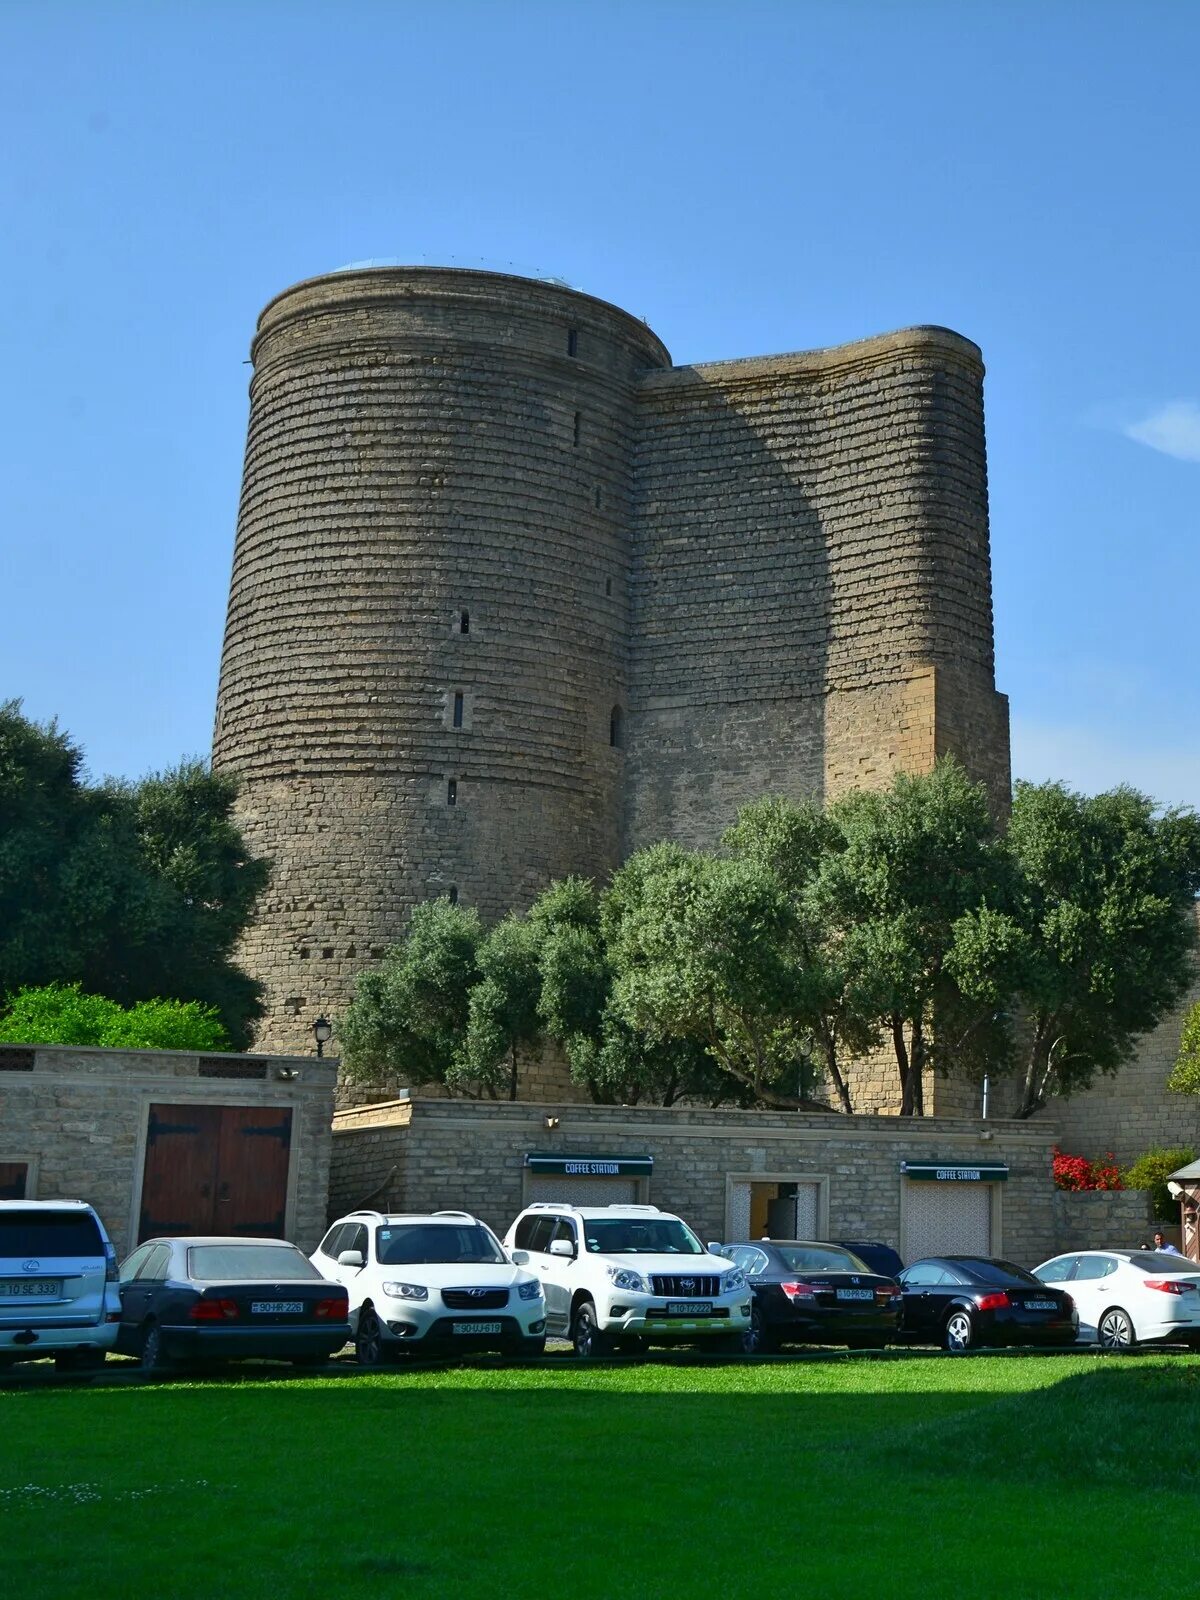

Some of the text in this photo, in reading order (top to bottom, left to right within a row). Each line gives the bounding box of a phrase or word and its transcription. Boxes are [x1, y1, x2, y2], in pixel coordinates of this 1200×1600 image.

[565, 1163, 619, 1174] COFFEE STATION
[936, 1170, 981, 1180] COFFEE STATION
[8, 1284, 56, 1294] 10 SE 333
